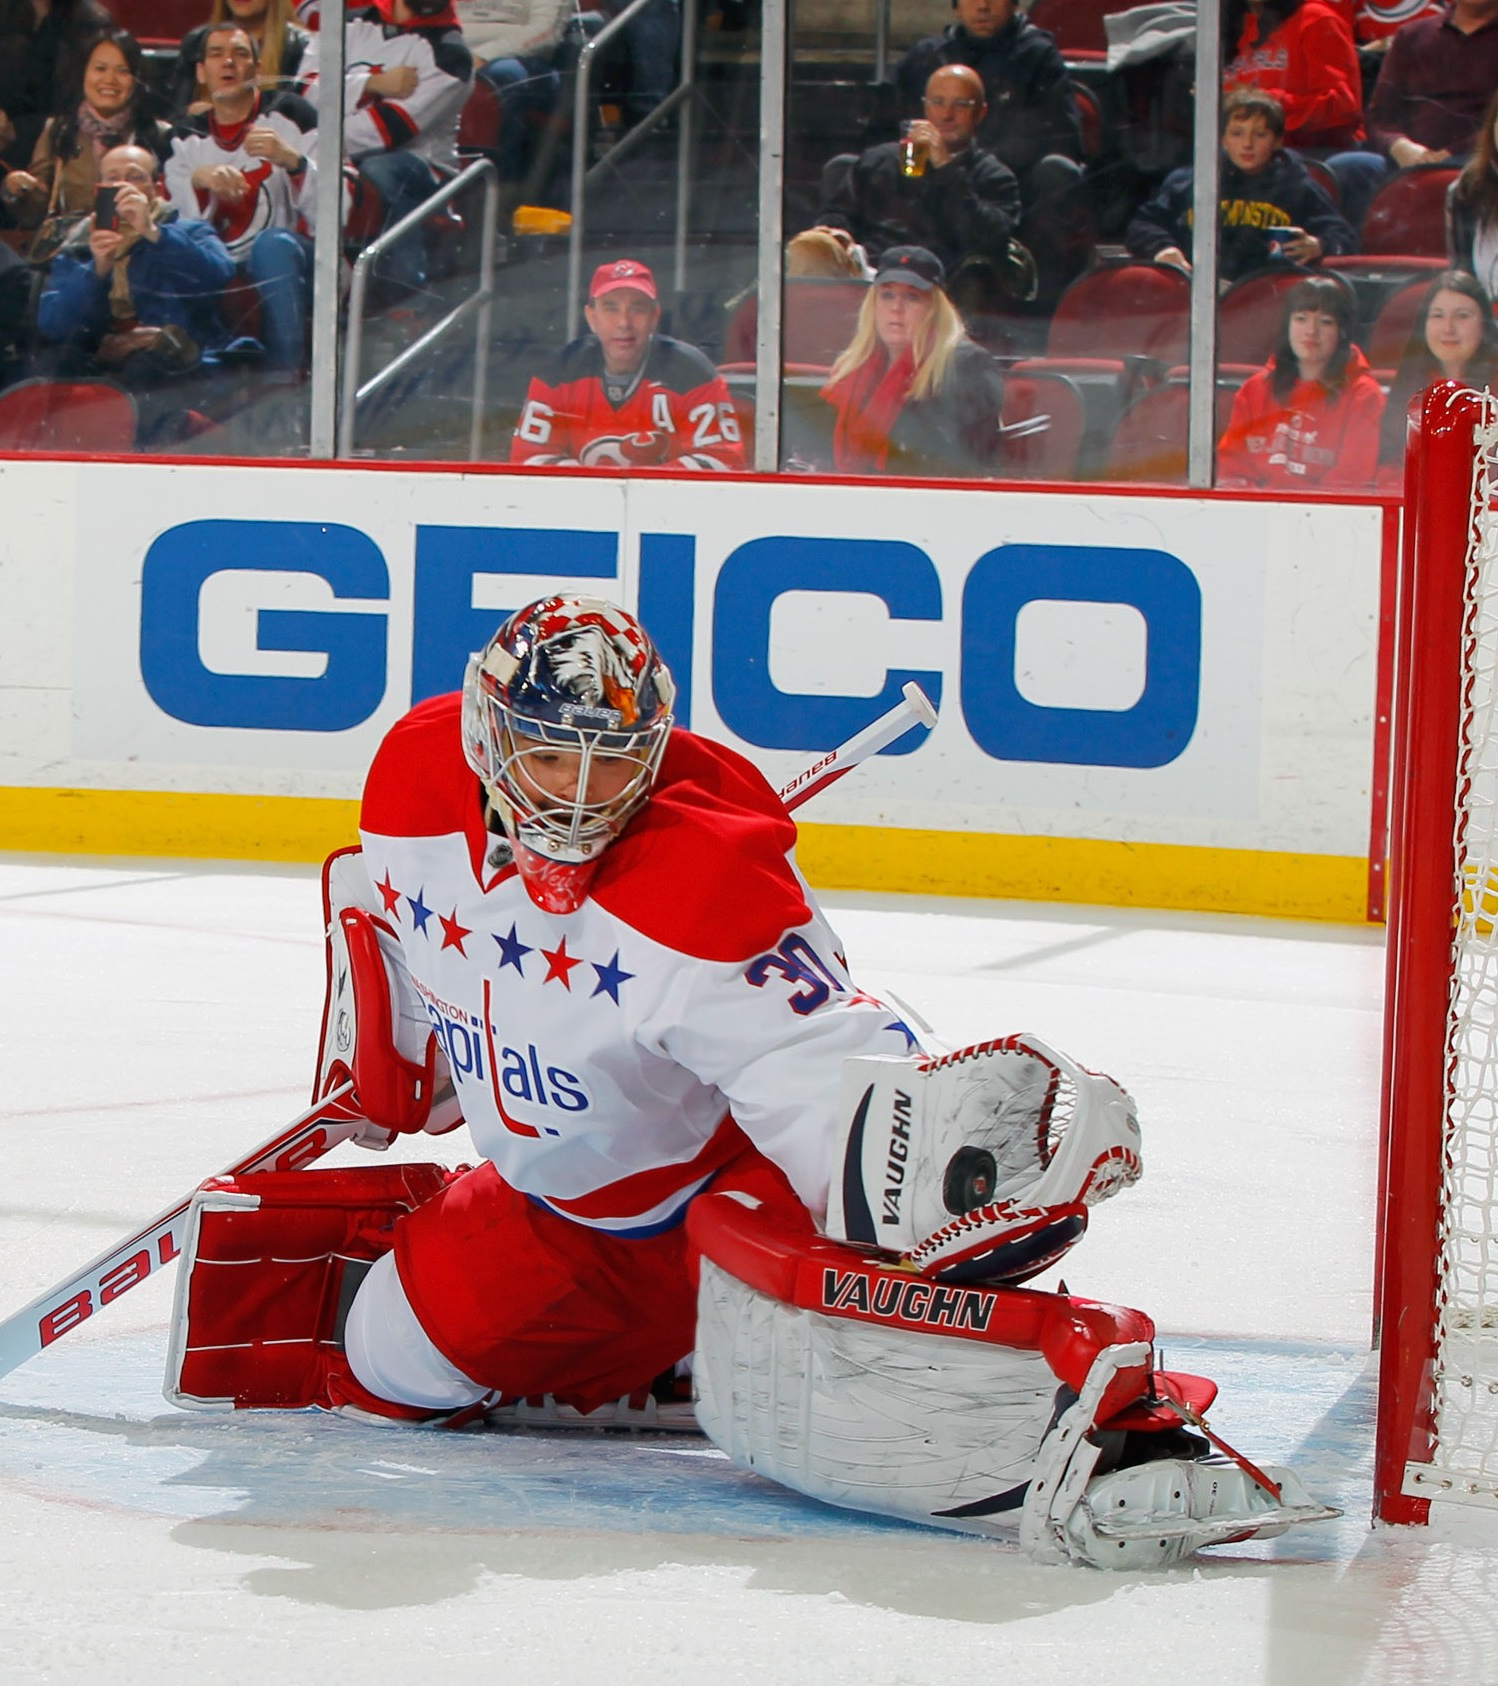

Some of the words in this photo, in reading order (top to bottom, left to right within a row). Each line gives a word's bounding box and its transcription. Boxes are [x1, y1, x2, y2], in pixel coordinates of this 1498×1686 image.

[513, 400, 554, 445] 6
[688, 402, 741, 448] 26
[139, 517, 1202, 769] GEICO
[744, 932, 847, 1016] 30
[416, 979, 590, 1138] apitals
[881, 1088, 913, 1226] VAUGHN
[822, 1268, 998, 1332] VAUGHN
